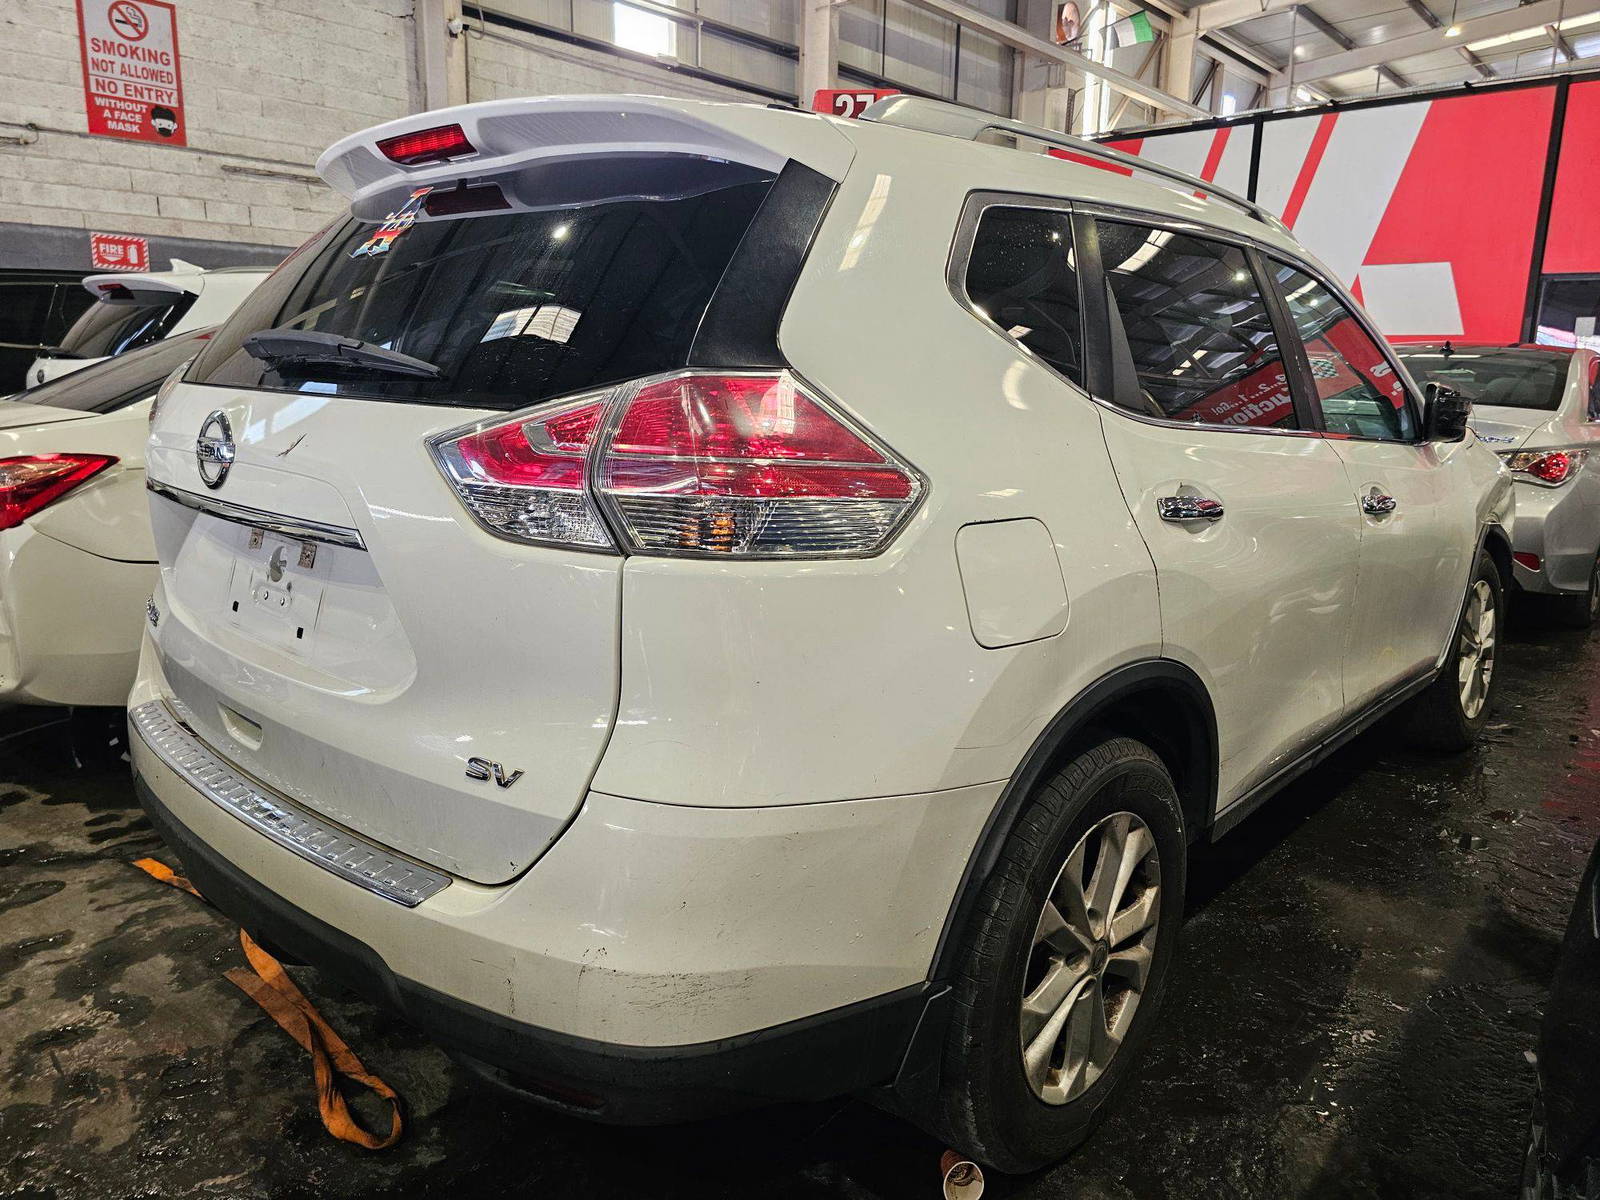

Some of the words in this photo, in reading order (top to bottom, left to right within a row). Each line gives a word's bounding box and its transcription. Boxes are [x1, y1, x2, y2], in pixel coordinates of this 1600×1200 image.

[90, 37, 171, 66] SMOKING
[91, 57, 116, 74] NOT
[120, 63, 174, 85] ALLOWED
[95, 78, 118, 94] NO
[124, 83, 174, 104] ENTRY
[94, 97, 148, 113] WITHOUT
[103, 109, 112, 118] A
[114, 111, 142, 123] FACE
[107, 120, 140, 133] MASK
[99, 242, 124, 256] FIRE
[465, 757, 525, 789] SV
